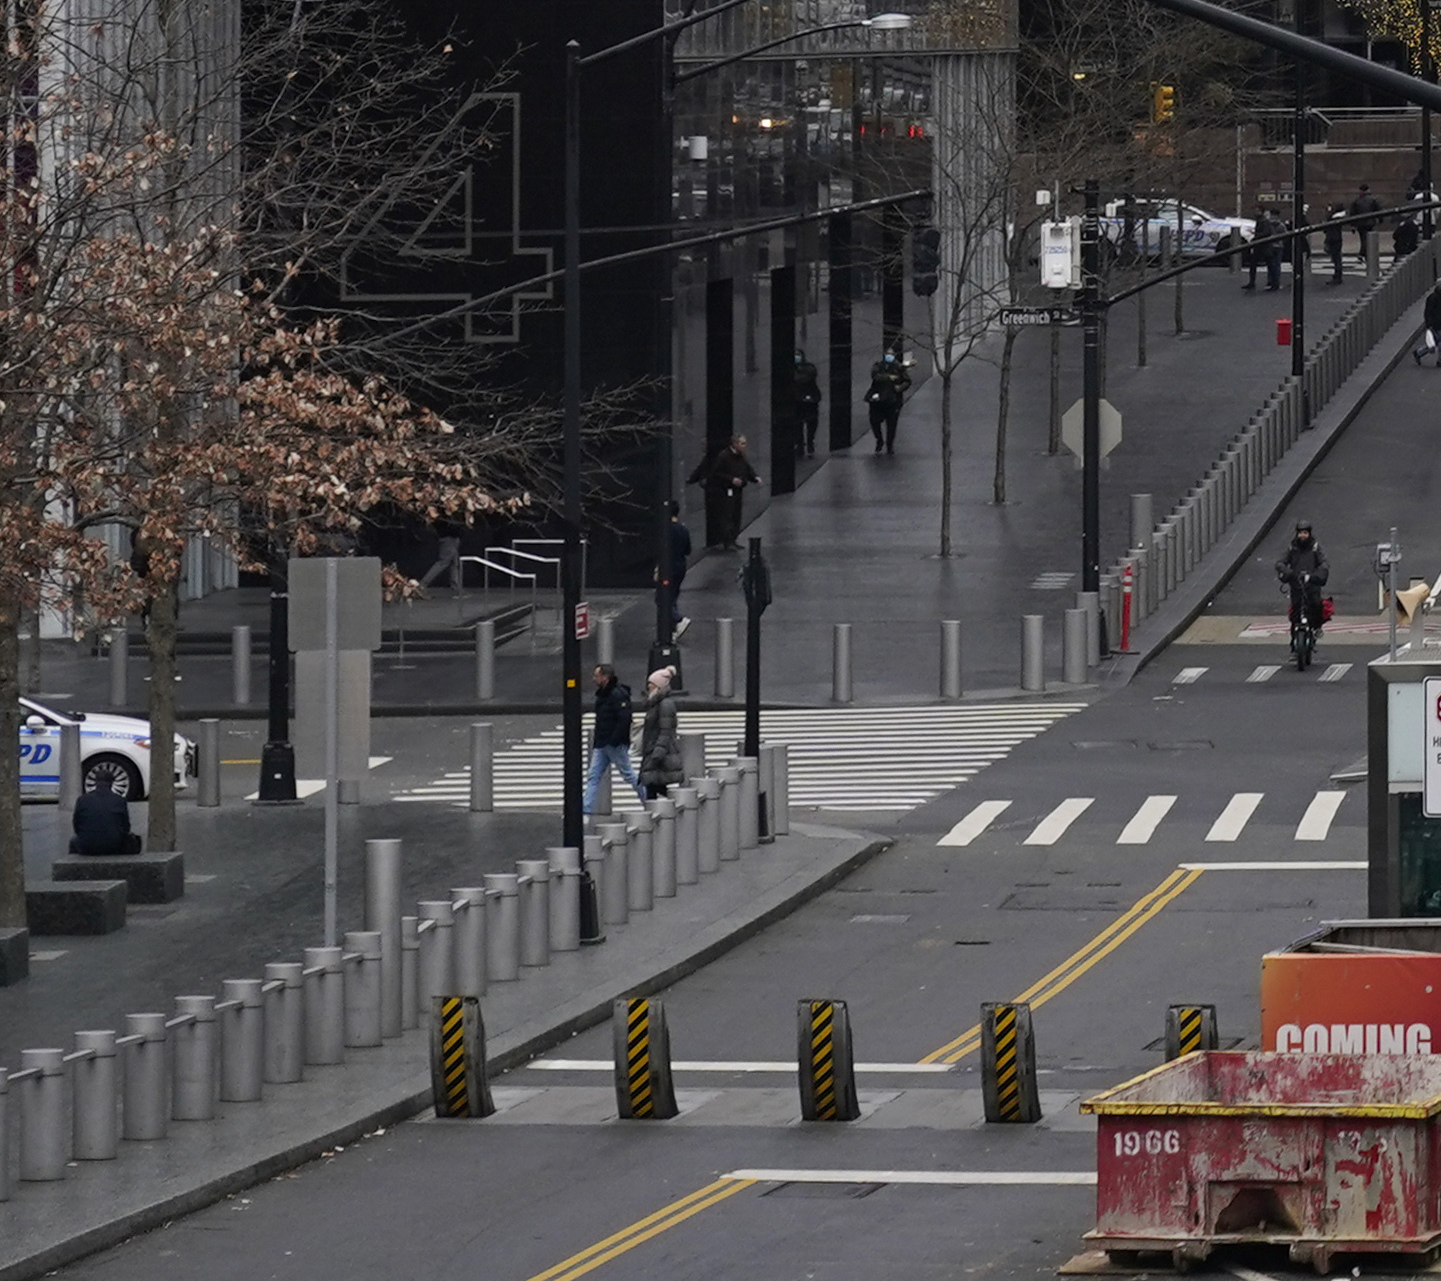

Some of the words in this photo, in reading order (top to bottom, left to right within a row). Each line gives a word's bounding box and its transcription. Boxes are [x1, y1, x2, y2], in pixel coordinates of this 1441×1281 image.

[340, 93, 553, 342] 4
[1002, 310, 1051, 325] Greenwich
[1276, 1023, 1432, 1055] COMING
[1113, 1129, 1180, 1156] 1966
